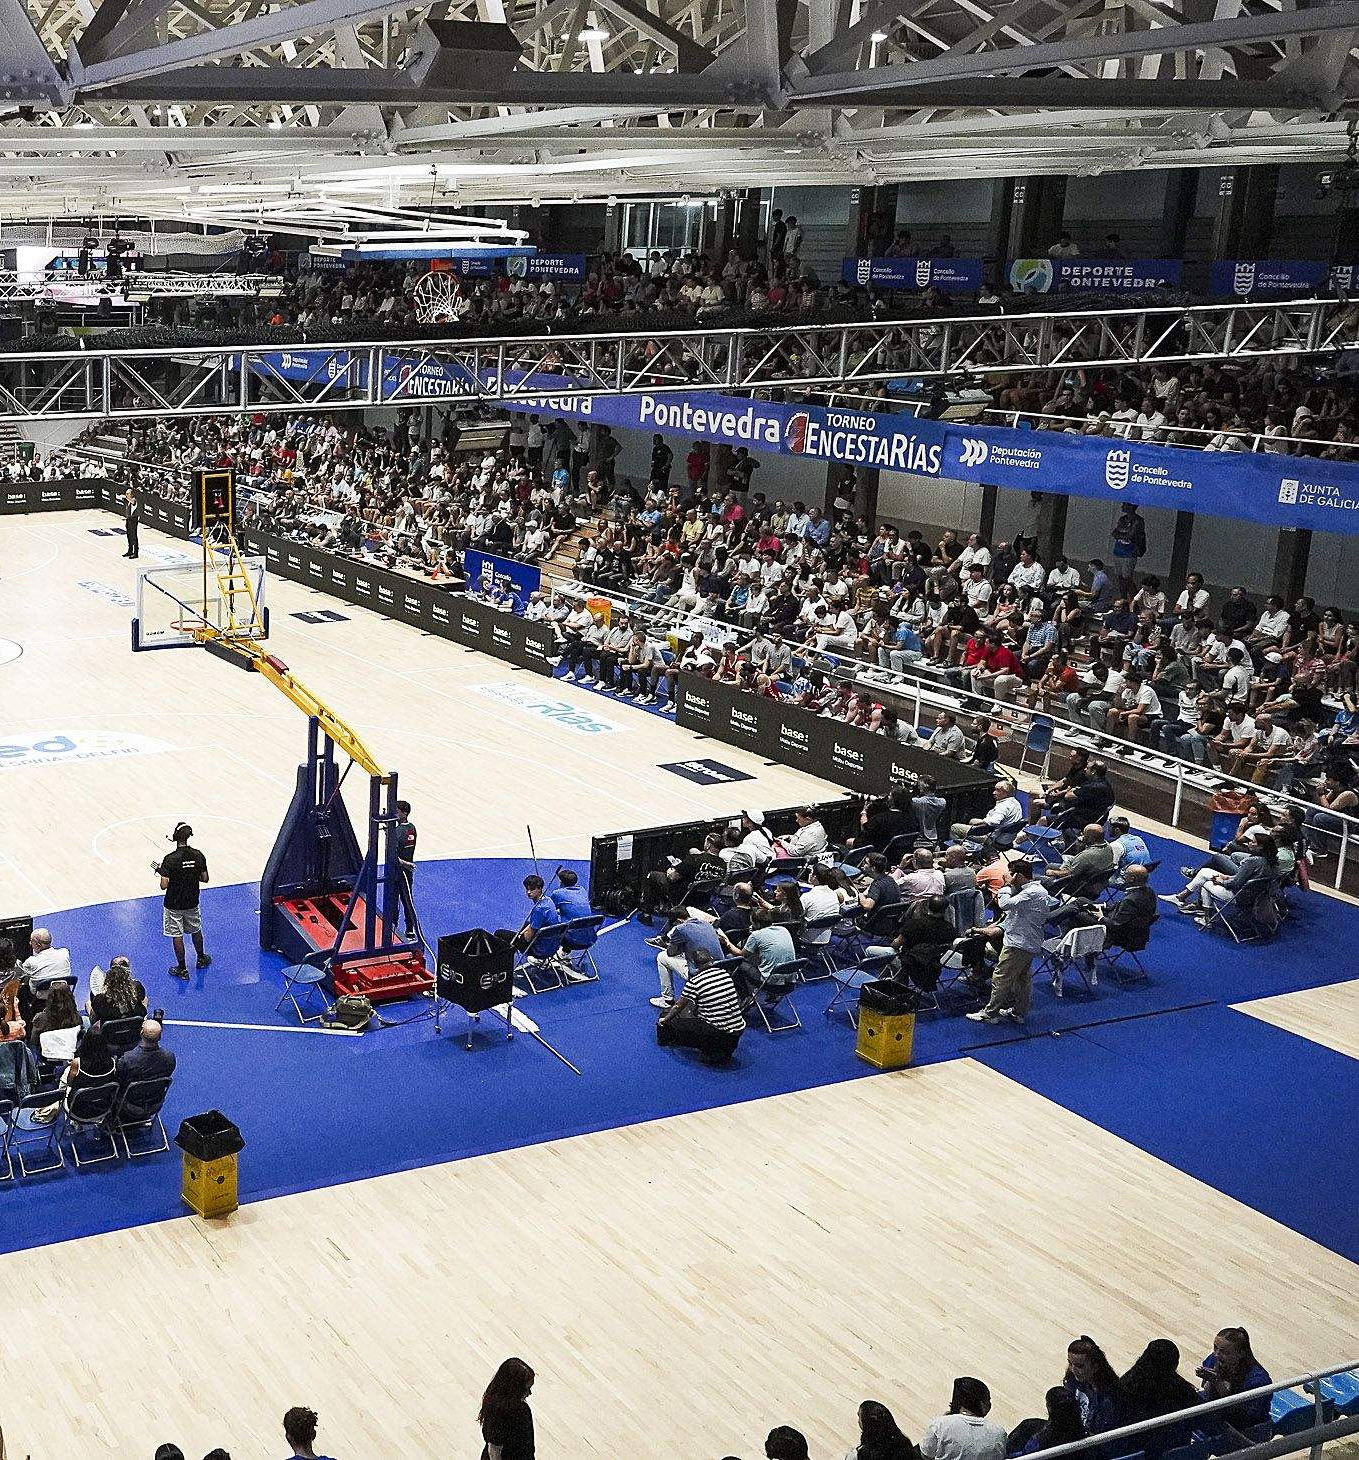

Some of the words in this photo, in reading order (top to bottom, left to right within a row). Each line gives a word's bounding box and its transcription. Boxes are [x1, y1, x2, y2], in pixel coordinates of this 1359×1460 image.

[530, 258, 564, 266] DEPORTE
[530, 265, 580, 275] PONTEVEDRA
[1061, 266, 1134, 276] DEPORTE
[1258, 272, 1290, 281] Concello
[1061, 277, 1166, 288] ONTEVEDRA
[640, 396, 780, 442] Pontevedra
[826, 413, 876, 431] TORNEO
[991, 445, 1041, 459] Deputación
[989, 455, 1039, 469] Pontevedra
[1132, 463, 1168, 476] Concello
[1131, 474, 1142, 483] de
[1142, 475, 1192, 489] Pontevedra
[1301, 484, 1340, 496] XUNTA
[1299, 494, 1315, 504] DE
[685, 691, 710, 708] base:
[731, 707, 758, 725] base:
[781, 724, 809, 743] base:
[833, 742, 864, 761] base:
